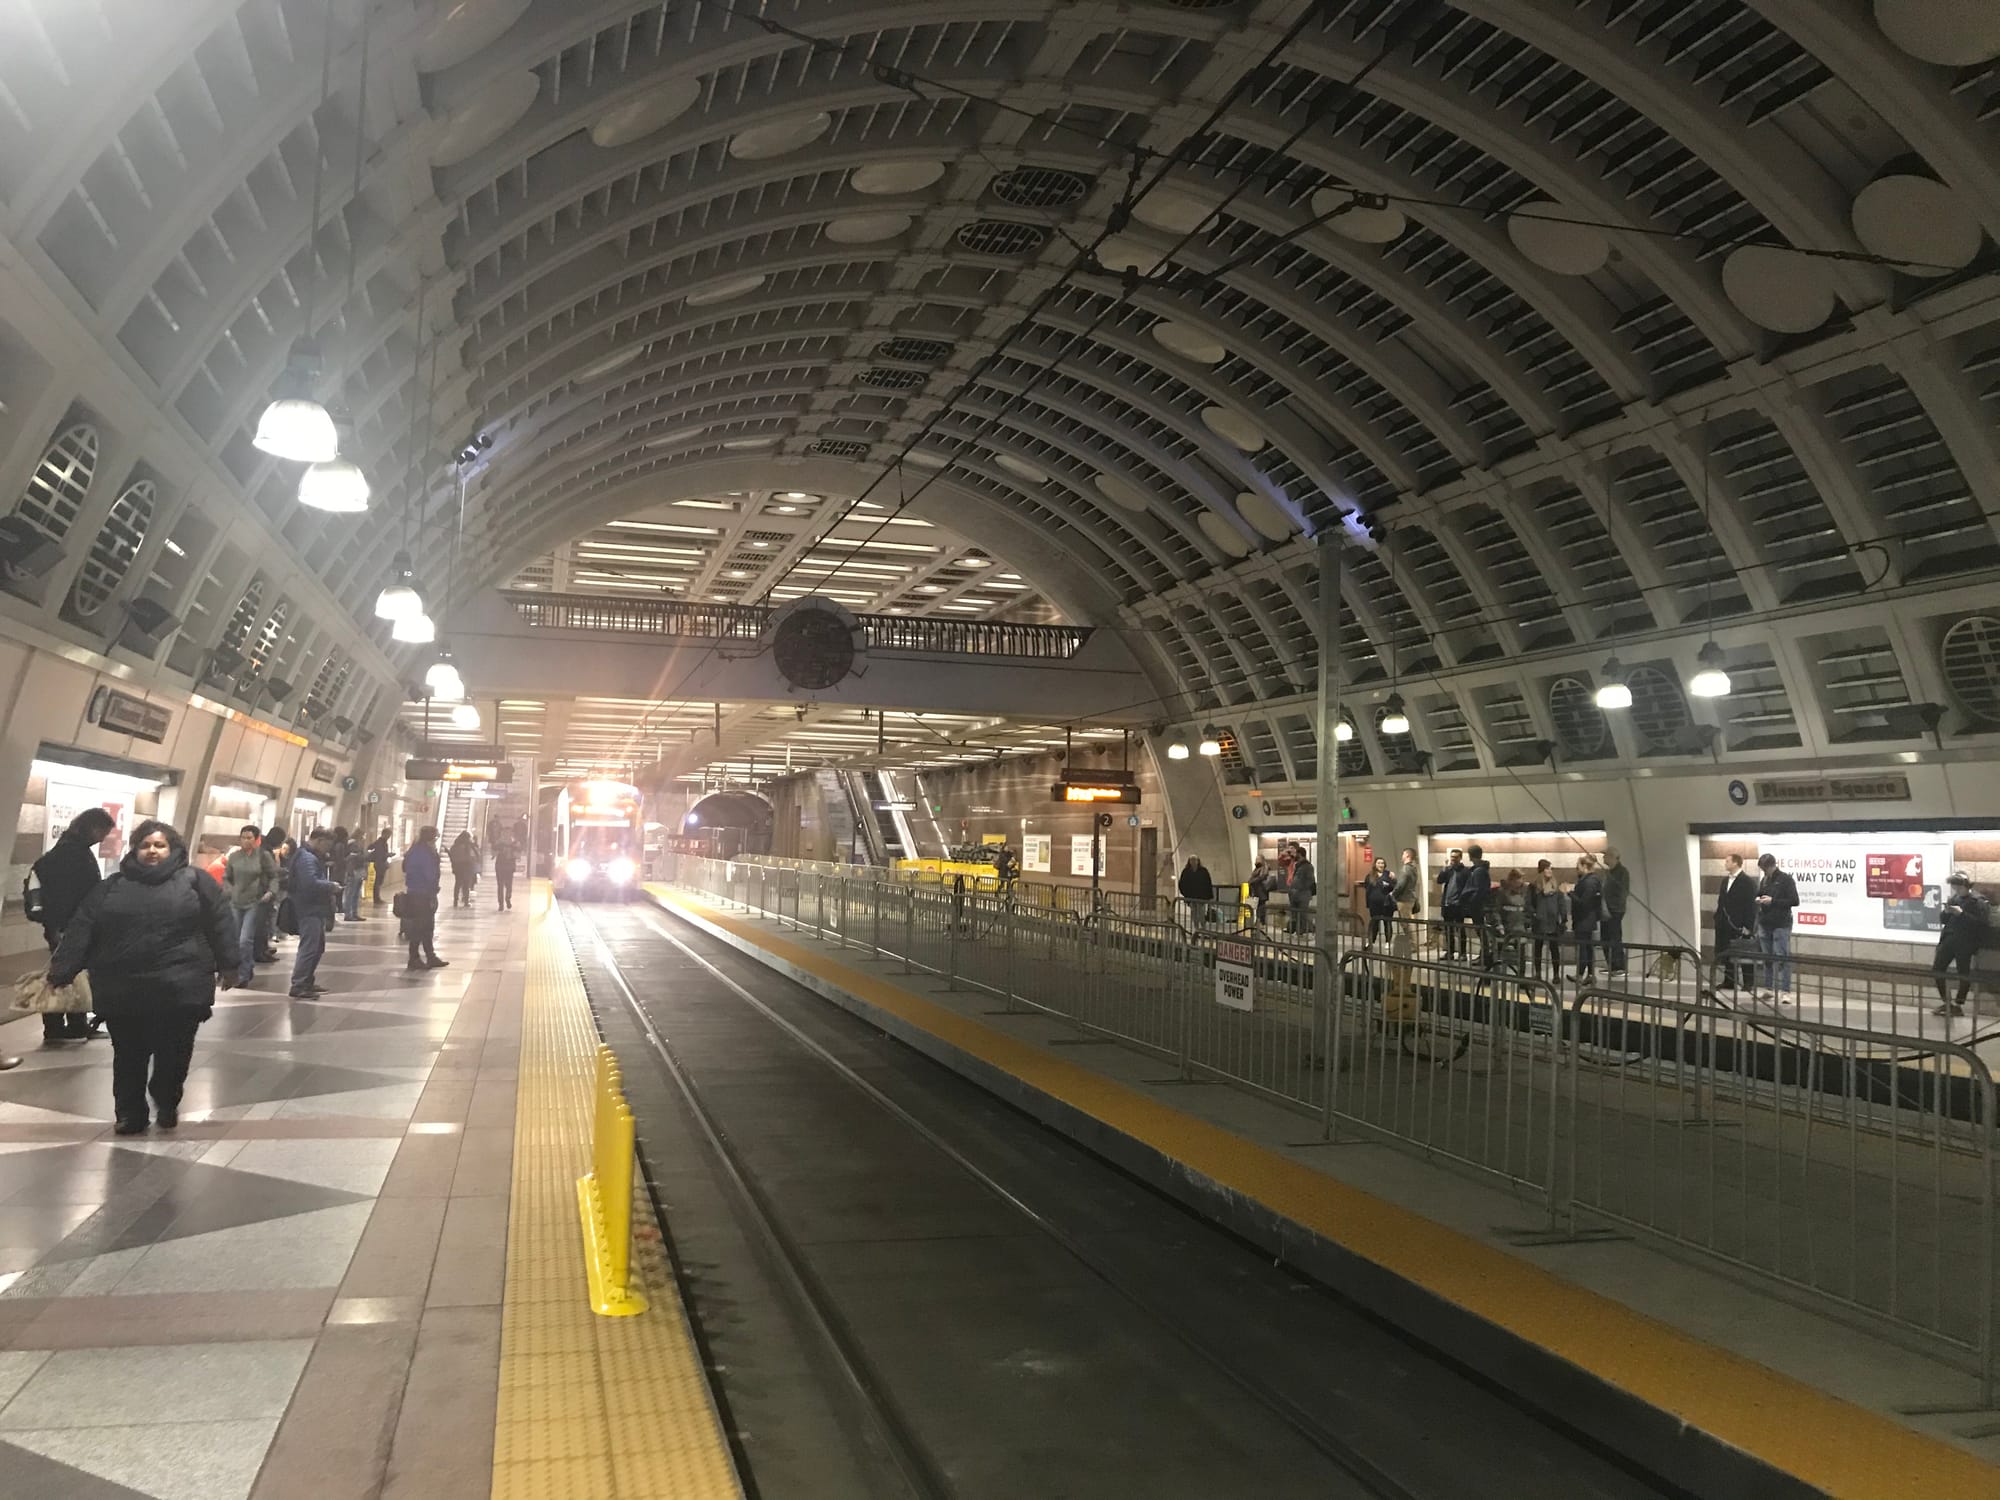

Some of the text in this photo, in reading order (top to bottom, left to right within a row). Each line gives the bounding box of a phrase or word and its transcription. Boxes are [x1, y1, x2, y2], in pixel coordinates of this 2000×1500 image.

[1760, 780, 1897, 799] Pioneer Square
[1103, 816, 1110, 825] 2
[1787, 859, 1832, 869] CRIMSON
[1834, 859, 1856, 869] AND
[1796, 872, 1817, 883] WAY
[1819, 872, 1833, 883] TO
[1836, 873, 1855, 884] PAY
[1800, 914, 1825, 922] BECU
[1218, 941, 1251, 964] DANGER
[1219, 969, 1249, 988] OVERHEAD
[1224, 984, 1244, 1000] POWER
